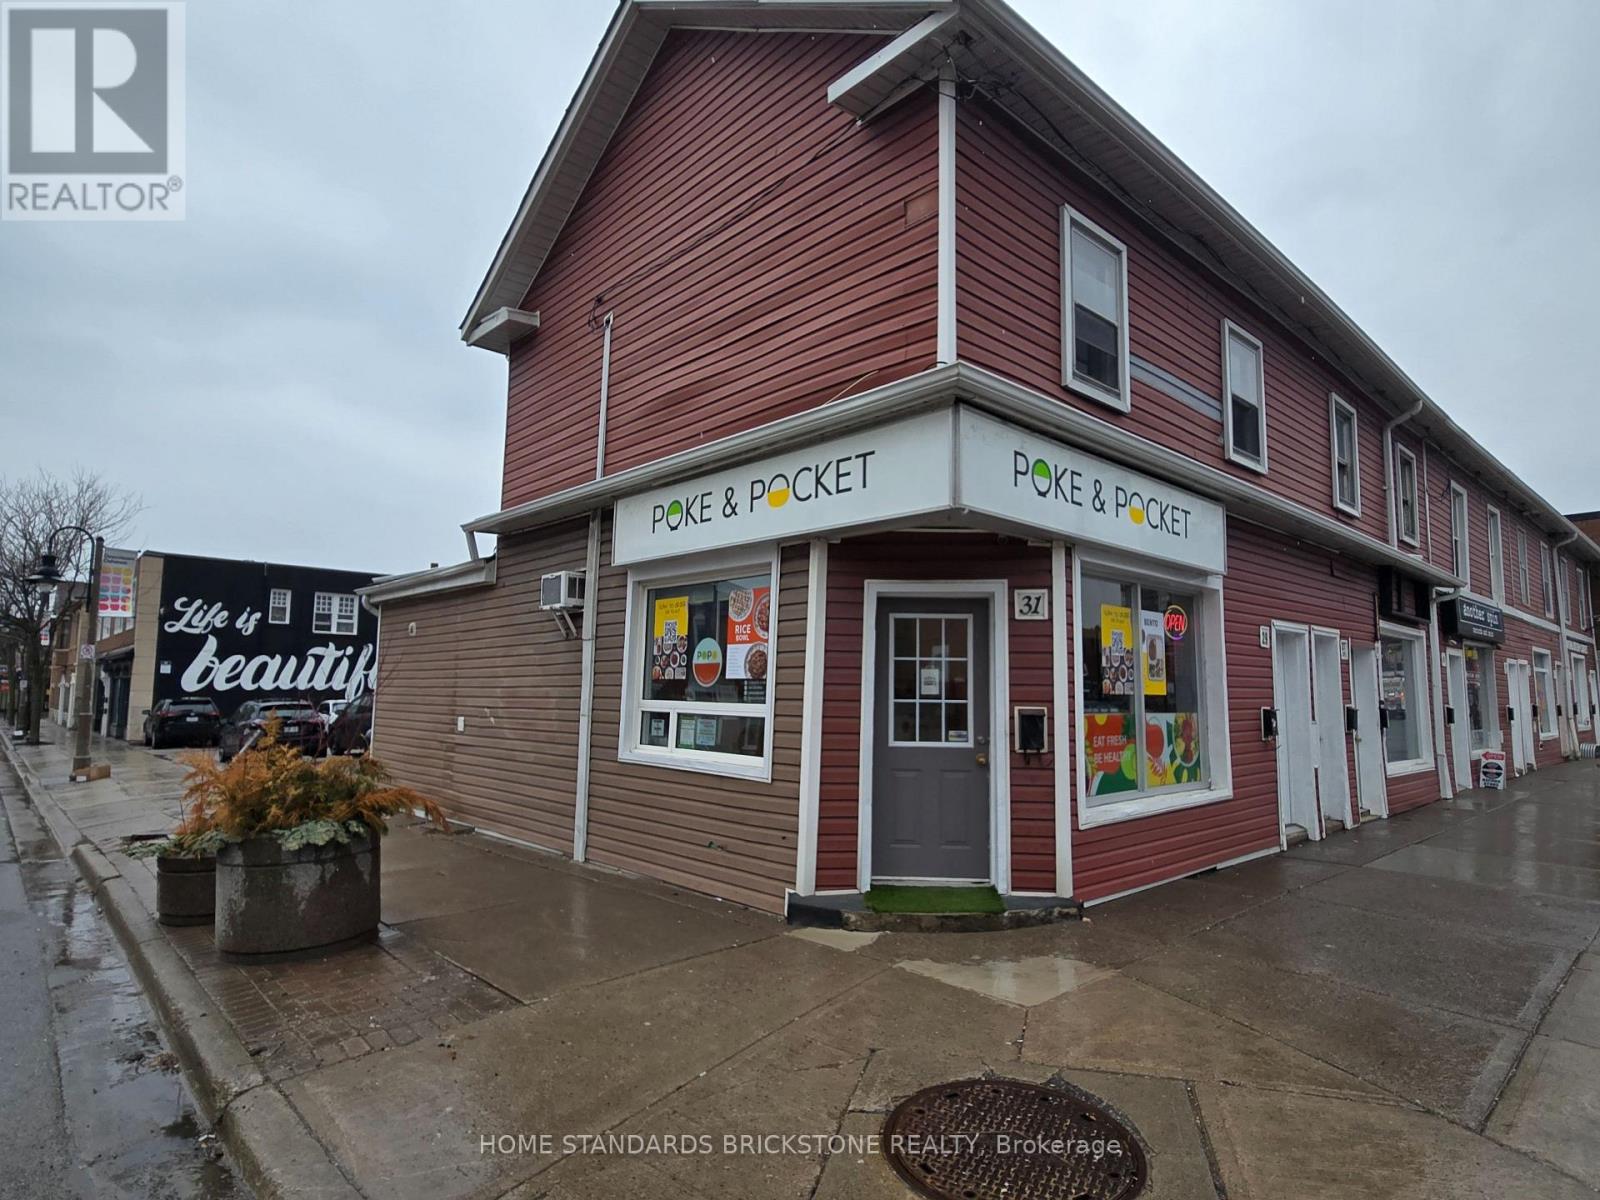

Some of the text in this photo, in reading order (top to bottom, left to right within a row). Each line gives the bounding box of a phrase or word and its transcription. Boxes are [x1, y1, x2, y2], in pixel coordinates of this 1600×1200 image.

[652, 450, 875, 534] POKE & POCKET
[1013, 450, 1191, 539] POKE & POCKET
[1019, 595, 1042, 615] 31
[164, 597, 262, 636] Life is
[1167, 614, 1185, 631] OPEN
[735, 624, 751, 634] RICE
[1093, 734, 1127, 748] EAT FRESH
[1094, 752, 1103, 764] BE
